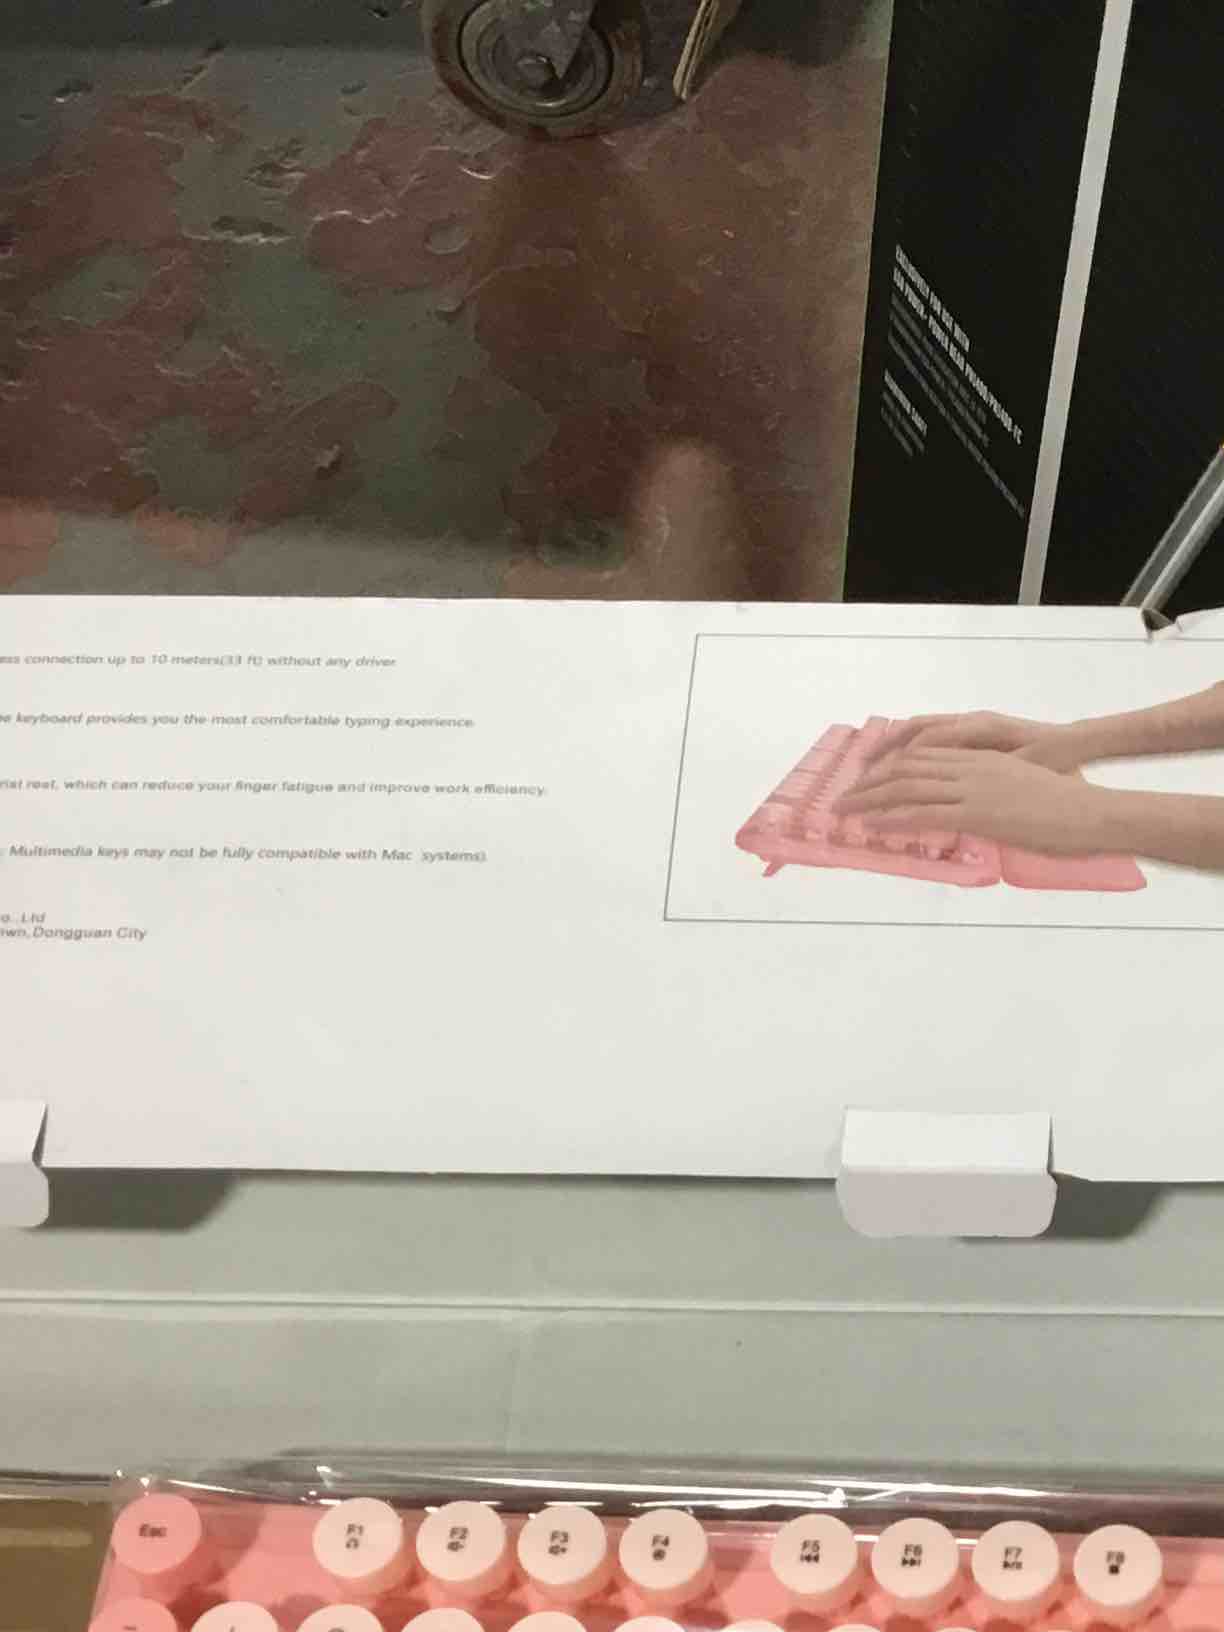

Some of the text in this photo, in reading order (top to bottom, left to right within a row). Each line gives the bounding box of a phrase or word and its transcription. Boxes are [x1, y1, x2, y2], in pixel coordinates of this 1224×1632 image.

[24, 654, 104, 665] connection
[108, 655, 127, 668] up
[131, 654, 145, 665] to
[151, 653, 168, 665] 10
[267, 655, 321, 667] without
[325, 657, 351, 669] any
[16, 711, 82, 727] keyboard
[86, 713, 147, 727] provides
[152, 714, 179, 727] you
[184, 712, 207, 726] the
[211, 714, 247, 727] most
[251, 713, 341, 728] comfortable
[345, 715, 390, 731] typing
[63, 778, 107, 791] which
[111, 780, 138, 791] can
[142, 779, 194, 792] reduce
[198, 781, 231, 794] your
[234, 779, 278, 794] finger
[281, 780, 334, 795] fatigue
[337, 781, 365, 794] and
[369, 781, 430, 797] improve
[434, 782, 470, 795] work
[9, 844, 93, 858] Multimedia
[97, 845, 129, 861] keys
[134, 847, 165, 861] may
[169, 846, 194, 859] not
[199, 846, 218, 859] be
[223, 846, 253, 862] fully
[257, 846, 341, 863] compatible
[345, 848, 377, 862] with
[381, 848, 413, 862] Mac
[116, 926, 147, 942] City
[139, 1524, 166, 1538] Esc
[347, 1524, 363, 1535] F1
[450, 1527, 468, 1540] F2
[550, 1531, 569, 1544] F3
[652, 1535, 669, 1547] F4
[802, 1540, 820, 1553] F5
[903, 1544, 922, 1558] F6
[1004, 1547, 1022, 1561] F7
[1107, 1551, 1125, 1565] F8
